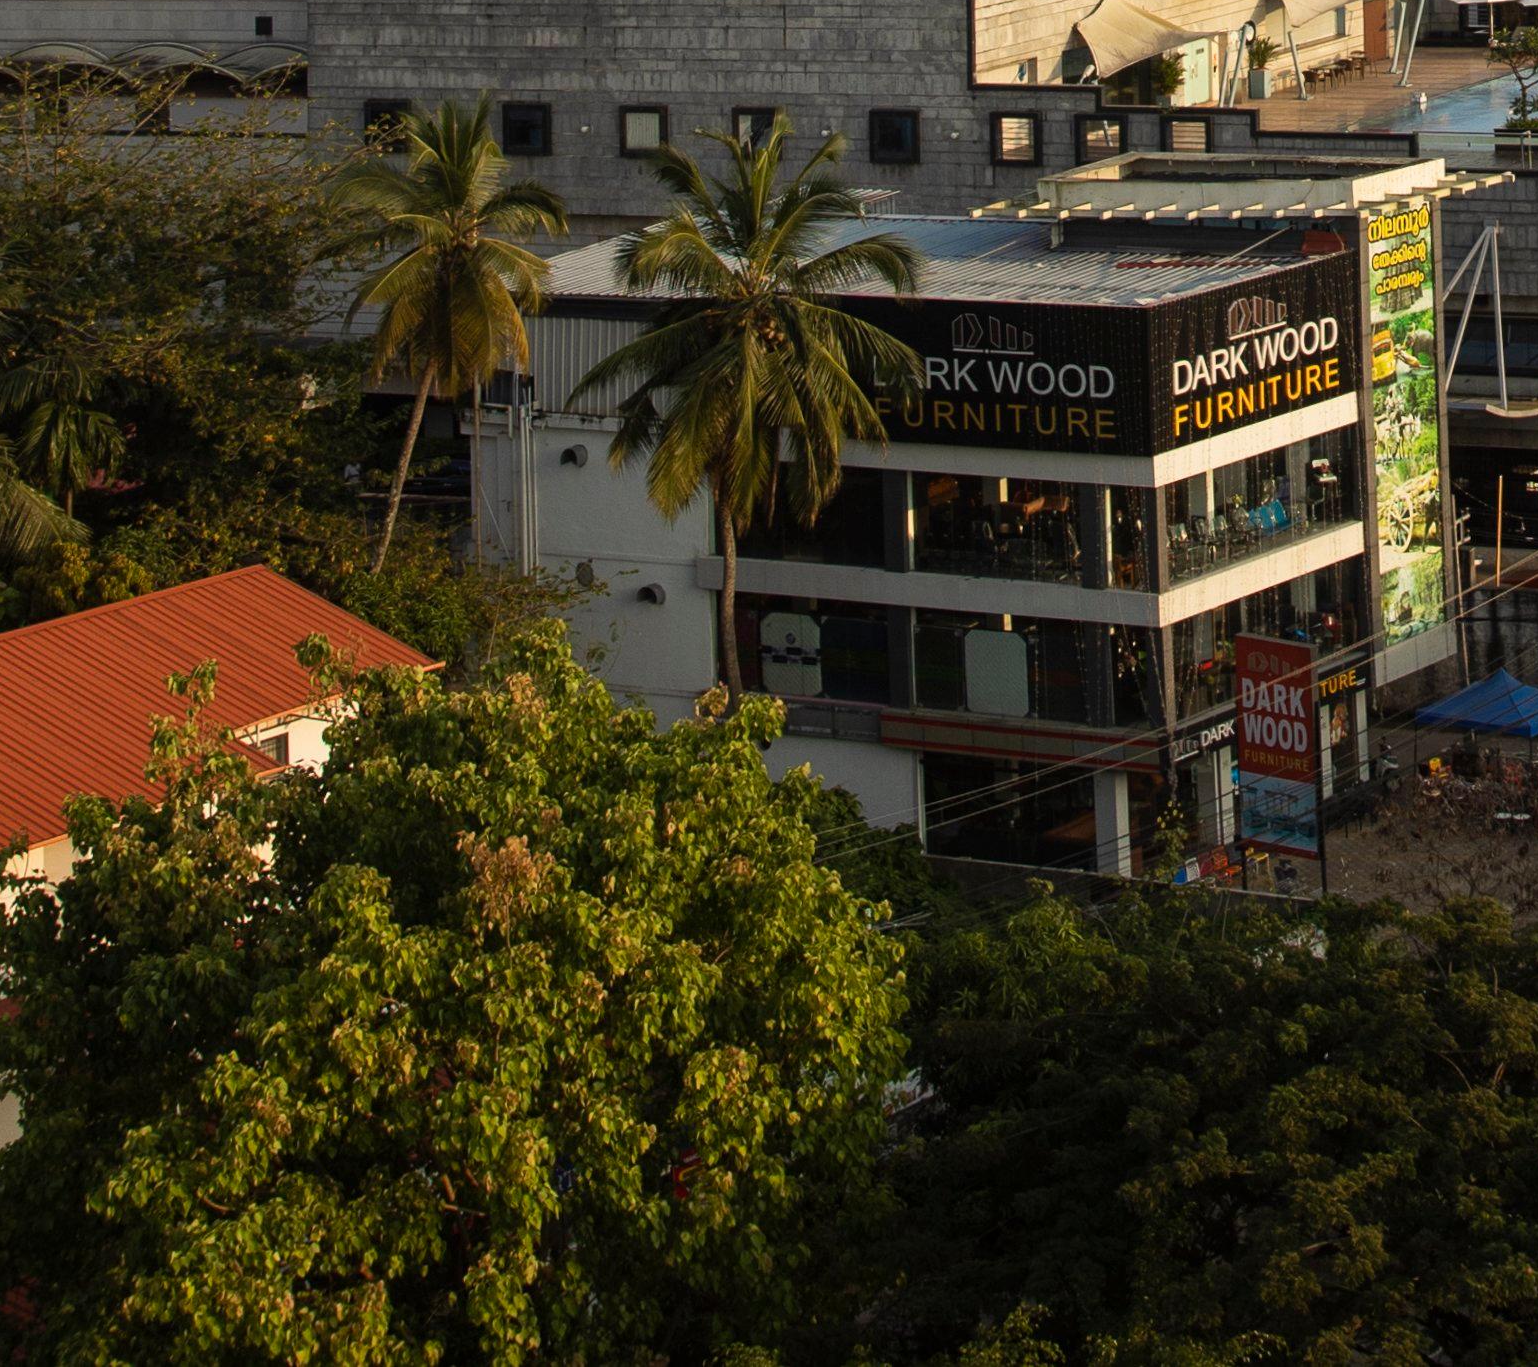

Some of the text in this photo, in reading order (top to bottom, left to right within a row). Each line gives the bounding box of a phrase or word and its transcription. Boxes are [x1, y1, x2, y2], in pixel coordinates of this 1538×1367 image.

[1173, 316, 1339, 396] DARK WOOD
[987, 360, 1116, 399] WOOD
[1174, 357, 1341, 437] FURNITURE
[874, 396, 1118, 440] FURNITURE
[1241, 677, 1306, 717] DARK
[1200, 719, 1236, 747] DARK
[1242, 712, 1308, 753] WOOD
[1244, 749, 1310, 772] FURNITURE
